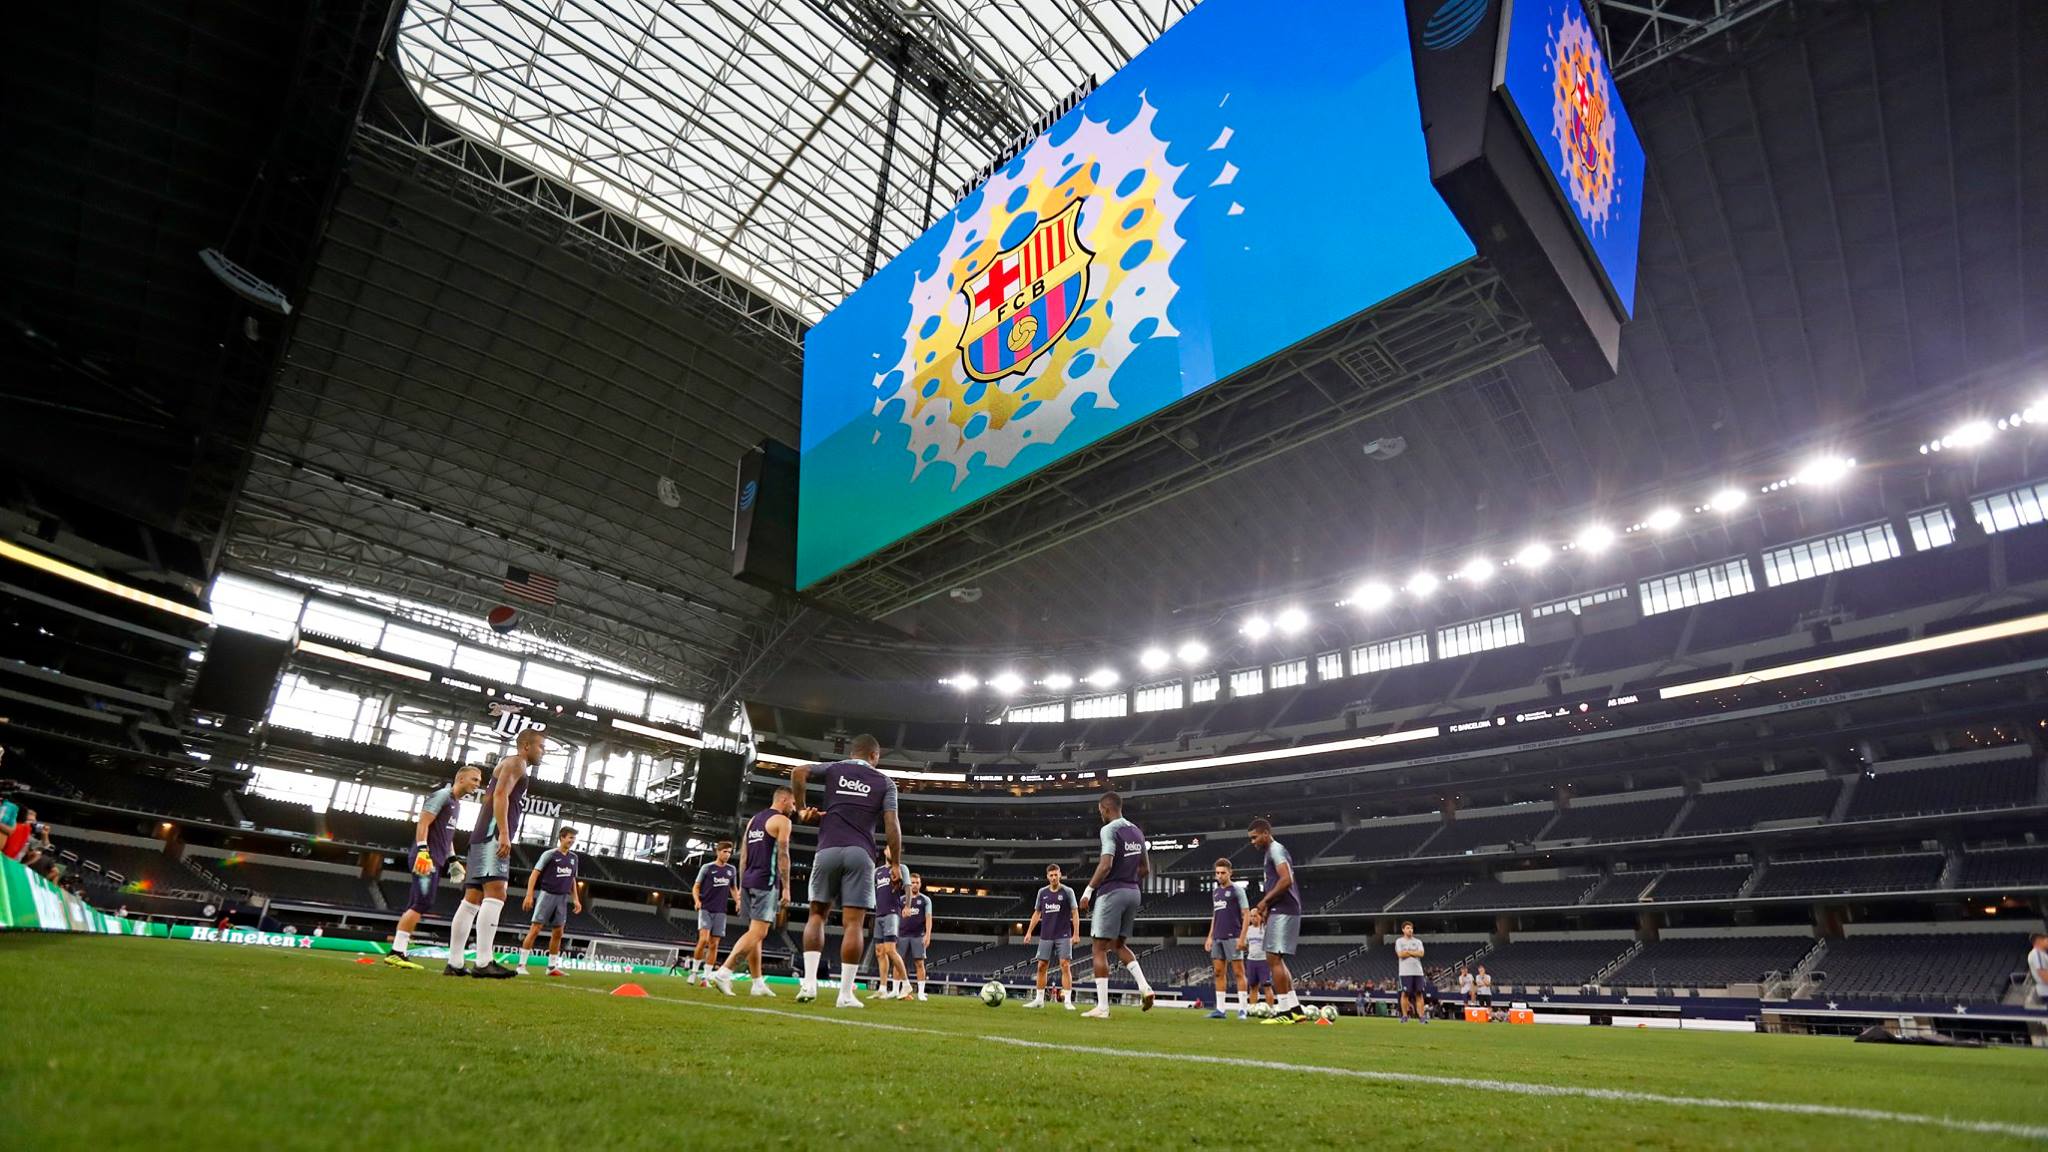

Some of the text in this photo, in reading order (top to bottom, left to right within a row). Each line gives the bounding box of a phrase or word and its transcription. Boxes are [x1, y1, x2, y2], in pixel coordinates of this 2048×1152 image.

[955, 154, 998, 203] AT&T
[997, 280, 1045, 322] FCB
[1608, 695, 1639, 708] AS ROMA
[494, 709, 547, 739] Lite
[1449, 720, 1492, 733] FC BARCELONA
[838, 775, 871, 793] beko
[1124, 841, 1141, 851] beko
[190, 926, 296, 948] Heineken
